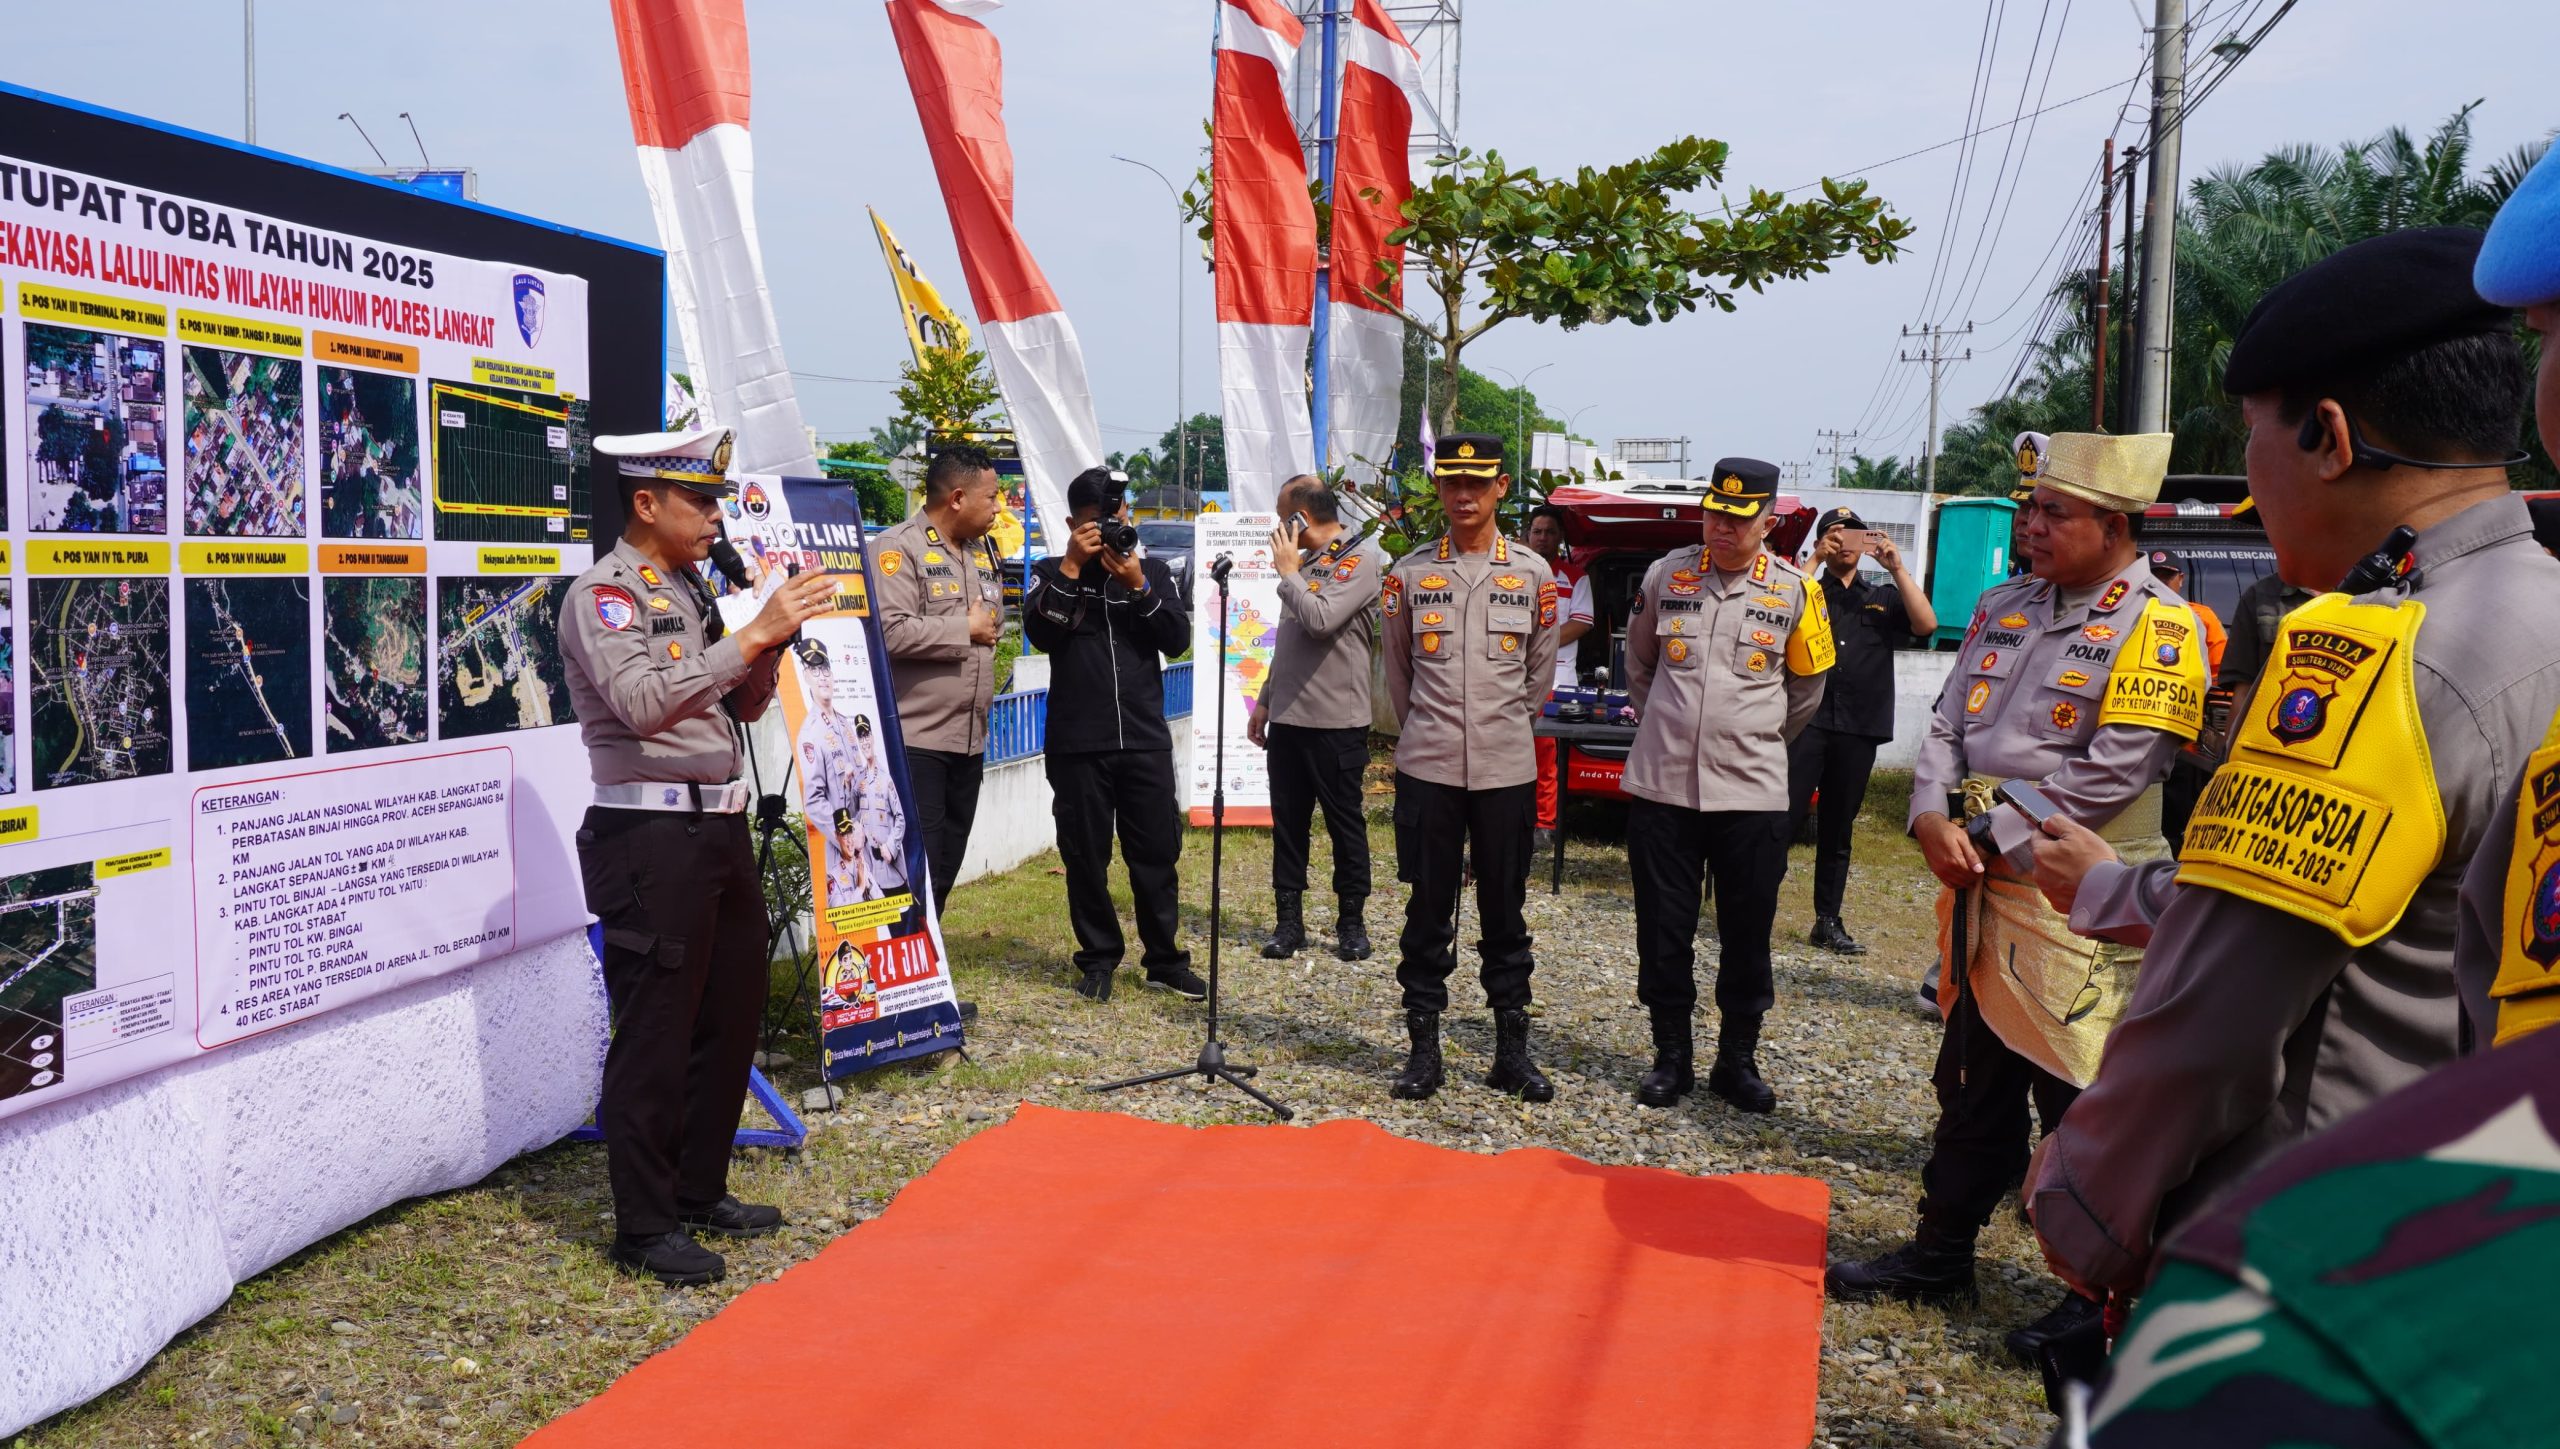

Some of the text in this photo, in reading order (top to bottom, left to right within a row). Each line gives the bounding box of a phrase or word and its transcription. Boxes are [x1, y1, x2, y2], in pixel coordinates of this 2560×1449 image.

[136, 193, 237, 248] TOBA
[245, 219, 353, 272] TAHUN
[363, 247, 434, 289] 2025
[515, 278, 526, 286] LALU
[101, 240, 220, 301] LALULINTAS
[224, 265, 303, 315] WILAYAH
[308, 282, 367, 327] HUKUM
[372, 295, 430, 338] POLRES
[434, 307, 495, 349] LANGKAT
[32, 294, 165, 327] POS YAN III TERMINAL PSR X HINAI
[188, 320, 302, 347] POS YAN V SIMP. TANGSI P. BRANDAN
[337, 343, 348, 354] POS
[350, 345, 361, 357] PAM
[366, 348, 381, 360] BUKIT
[1254, 516, 1271, 524] 2000
[757, 522, 859, 548] HOTLINE
[1206, 530, 1238, 538] TERPERCAYA
[1213, 539, 1231, 547] SUMUT
[1232, 539, 1247, 547] STAFF
[64, 551, 149, 564] POS YAN IV TG. PURA
[216, 553, 286, 563] POS YAN VI HALABAN
[346, 554, 357, 564] POS
[358, 554, 370, 564] PAM
[766, 550, 864, 571] POLRI MUDIK
[2172, 550, 2228, 559] ULANGAN
[926, 566, 954, 577] MARVEL
[1310, 568, 1330, 578] POLRI
[835, 595, 867, 611] LANGKAT
[1413, 591, 1453, 606] IWAN
[1489, 592, 1529, 607] POLRI
[1660, 600, 1703, 612] FERRY.W
[1745, 607, 1790, 628] POLRI
[2156, 620, 2188, 635] POLDA
[1984, 630, 2025, 647] WHISNU
[2295, 633, 2363, 662] POLDA
[2065, 643, 2111, 664] POLRI
[2112, 697, 2125, 708] OPS
[2116, 676, 2198, 709] KAOPSDA
[1580, 771, 1602, 779] Anda
[201, 790, 279, 812] KETERANGAN
[232, 780, 501, 833] PANJANG JALAN NASIONAL WILAYAH KAB. LANGKAT DARI
[232, 793, 504, 849] PERBATASAN BINJAI HINGGA PROV. ACEH SEPANGJANG 84
[233, 827, 469, 882] PANJANG JALAN TOL YANG ADA DI WILAYAH KAB.
[233, 852, 249, 865] KM
[234, 878, 286, 898] LANGKAT
[289, 865, 349, 887] SEPANJANG
[371, 858, 386, 869] KM
[234, 897, 267, 915] PINTU
[270, 895, 290, 907] TOL
[293, 886, 326, 902] BINJAI
[380, 869, 405, 883] YANG
[407, 861, 450, 876] TERSEDIA
[452, 857, 460, 867] DI
[462, 849, 499, 865] WILAYAH
[235, 879, 423, 931] KAB. LANGKAT ADA 4 PINTU TOL YAITU
[842, 908, 855, 916] David
[249, 911, 346, 943] PINTU TOL STABAT
[249, 922, 363, 959] PINTU TOL KW. BINGAI
[249, 940, 354, 975] PINTU TOL TG. PURA
[877, 938, 929, 983] 24 JAM
[236, 926, 510, 1012] RES AREA YANG TERSEDIA DI ARENA JL. TOL BERADA DI KM
[249, 951, 368, 991] PINTU TOL P. BRANDAN
[69, 994, 114, 1012] KETERANGAN
[236, 994, 321, 1027] 40 KEC. STABAT
